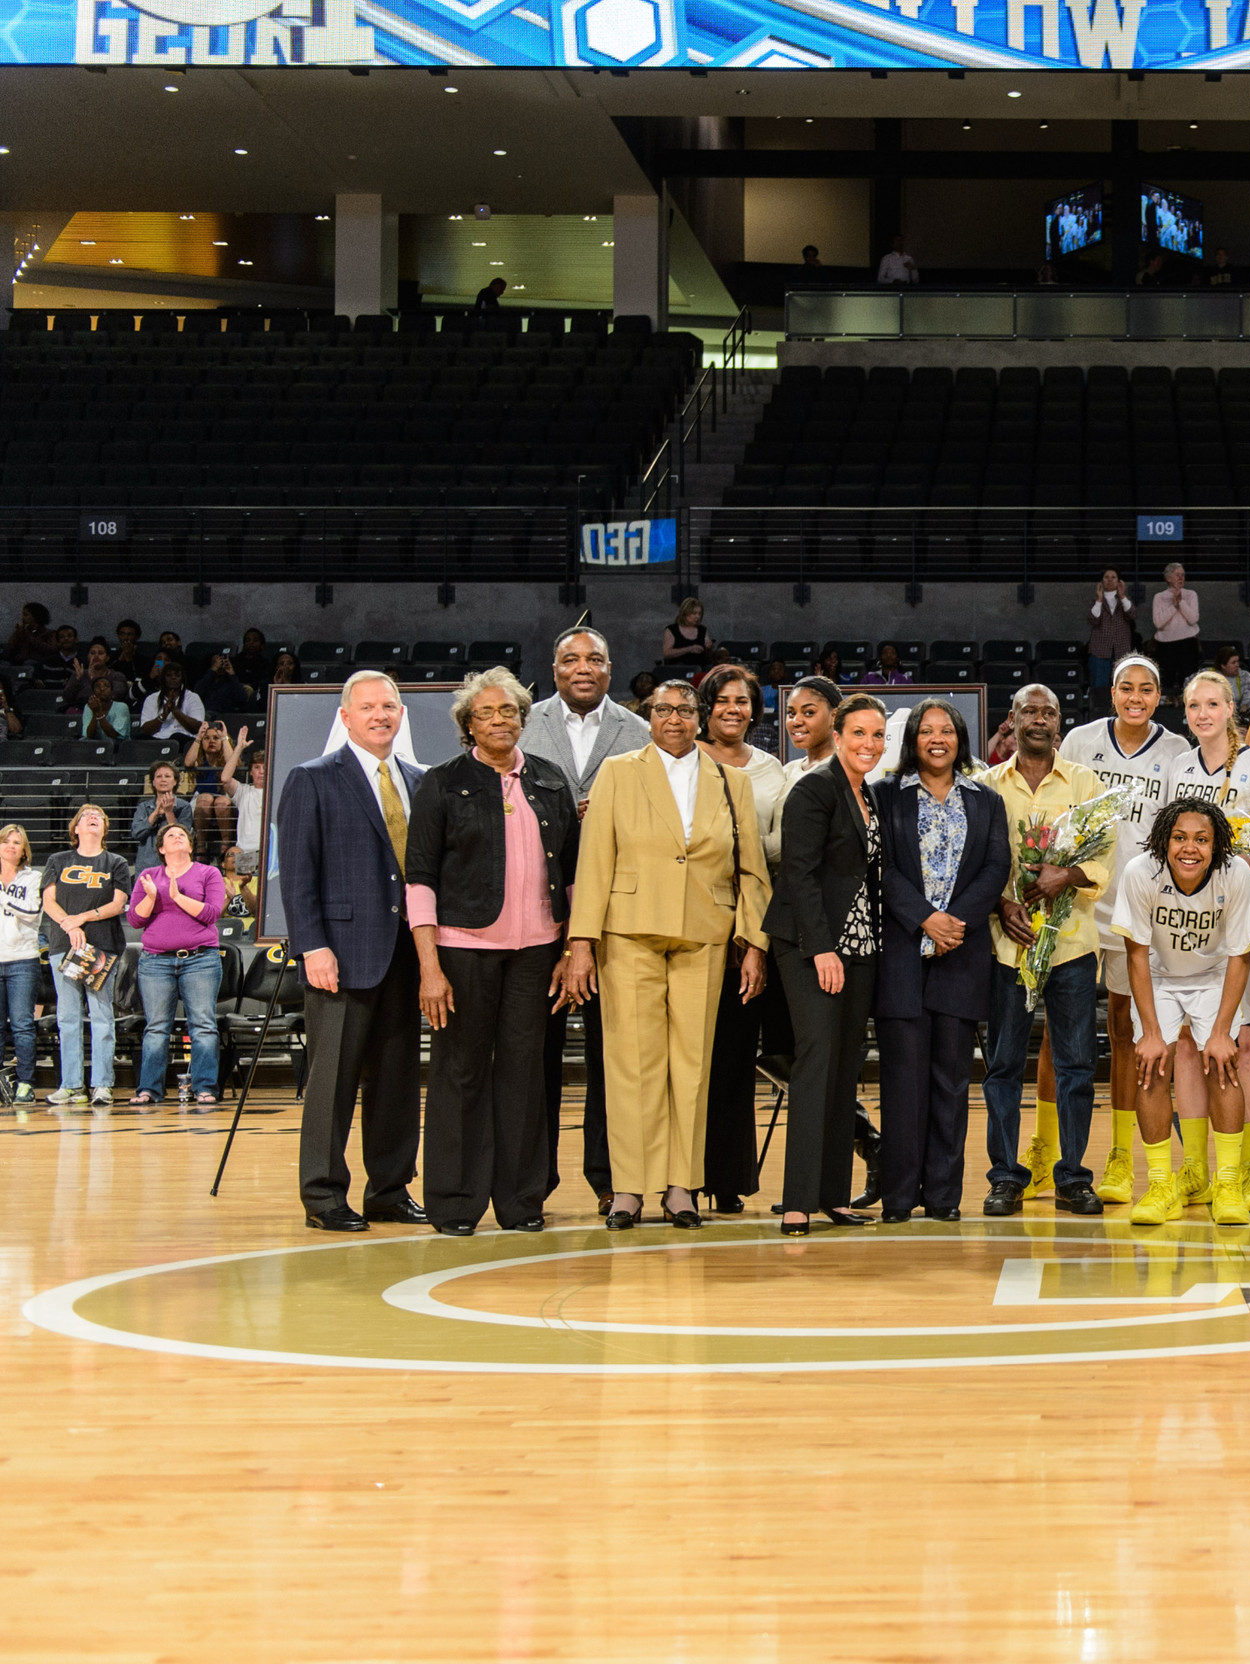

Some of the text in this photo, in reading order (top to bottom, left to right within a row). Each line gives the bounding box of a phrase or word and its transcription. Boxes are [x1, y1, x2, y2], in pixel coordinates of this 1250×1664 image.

[89, 521, 117, 535] 108
[1146, 521, 1175, 536] 109
[60, 865, 111, 889] GT
[1170, 932, 1210, 951] TECH
